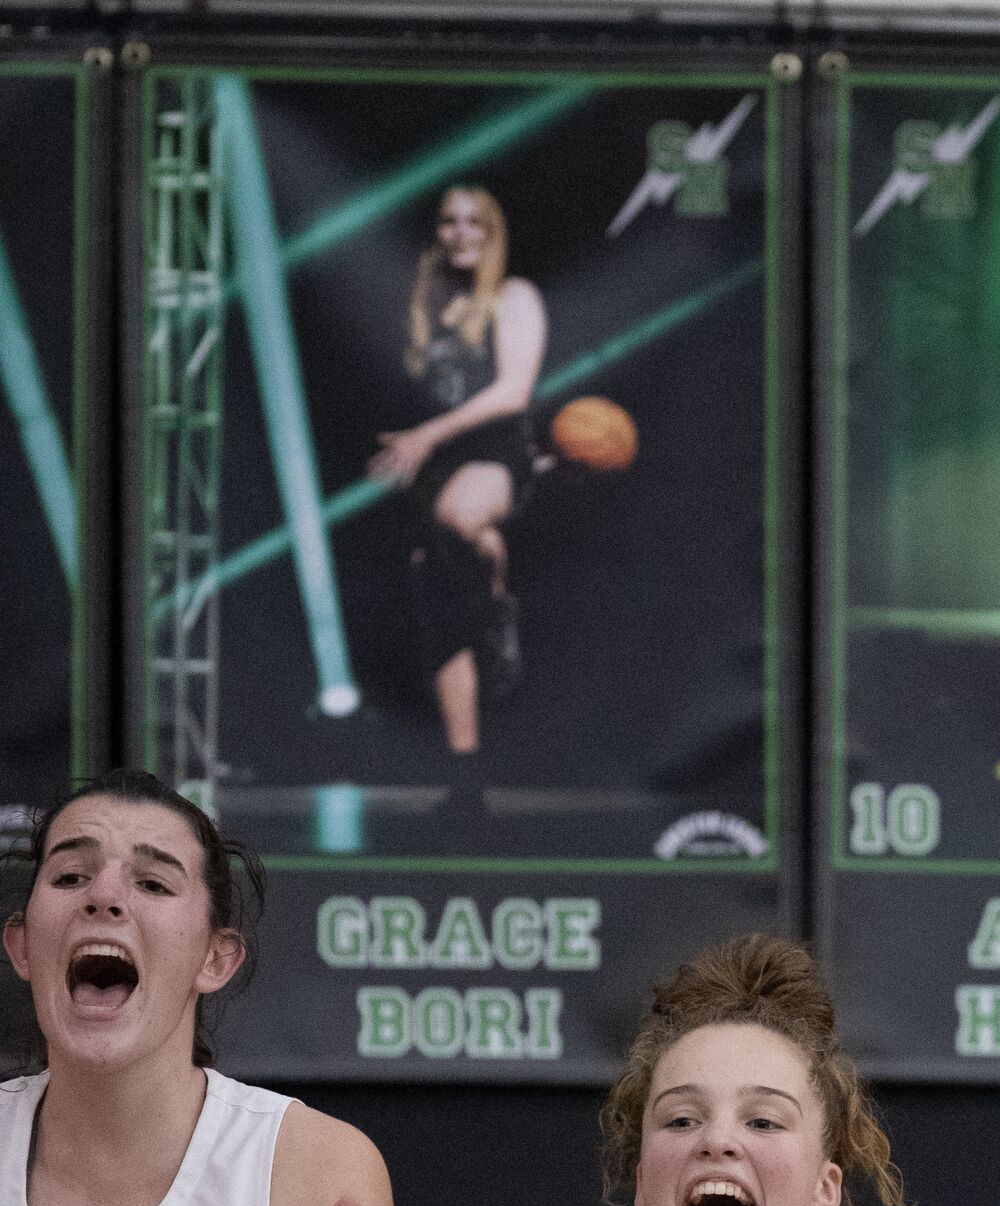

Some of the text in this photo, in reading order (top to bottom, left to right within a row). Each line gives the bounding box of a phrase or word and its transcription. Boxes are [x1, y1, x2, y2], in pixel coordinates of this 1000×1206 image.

[850, 782, 941, 856] 10
[317, 895, 601, 971] GRACE
[356, 985, 564, 1060] BORI
